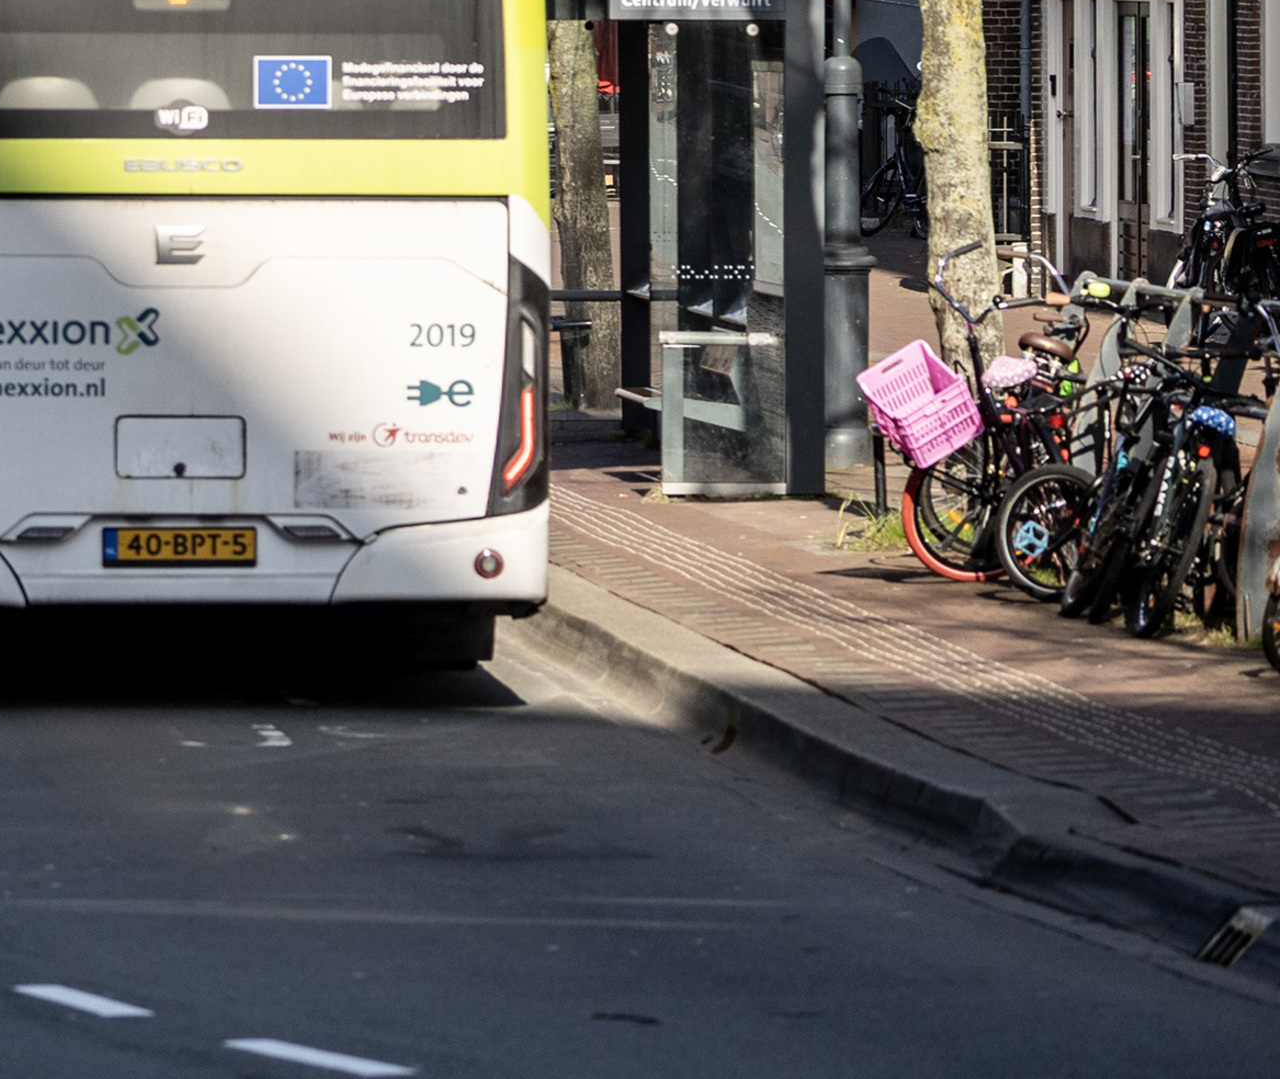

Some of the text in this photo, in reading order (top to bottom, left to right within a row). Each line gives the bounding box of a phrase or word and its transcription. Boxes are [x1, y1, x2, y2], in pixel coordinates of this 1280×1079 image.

[468, 62, 484, 74] de
[124, 159, 243, 173] EBUSCO
[410, 323, 476, 347] 2019
[15, 357, 47, 371] deur
[50, 359, 70, 371] tot
[73, 357, 106, 371] deur
[348, 432, 367, 445] zijn
[404, 430, 475, 444] transdev
[127, 533, 248, 557] 40-BPT-5
